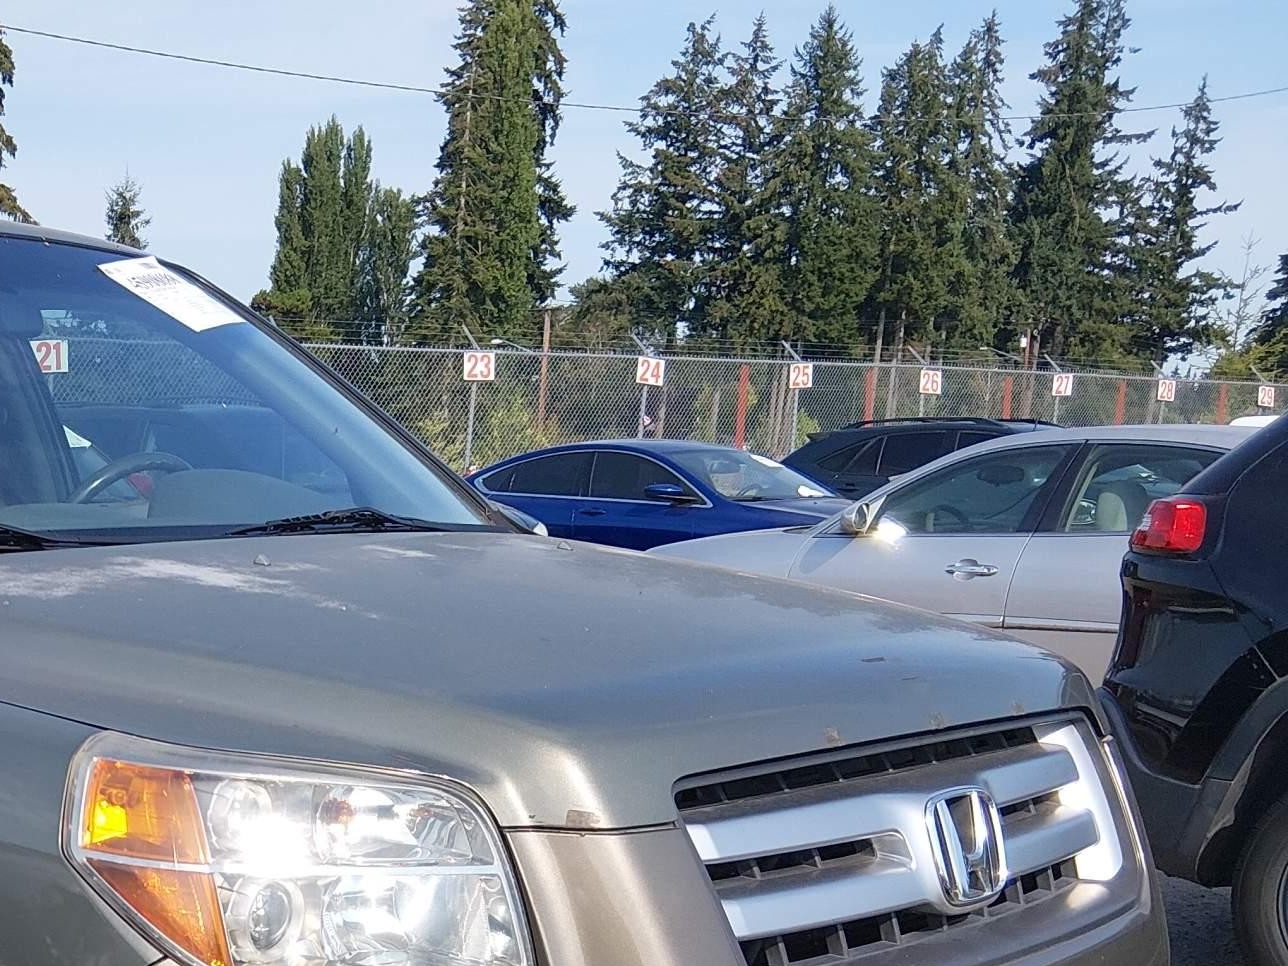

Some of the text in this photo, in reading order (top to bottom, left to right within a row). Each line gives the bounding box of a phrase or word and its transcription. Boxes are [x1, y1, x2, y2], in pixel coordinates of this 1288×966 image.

[36, 342, 62, 371] 21
[467, 354, 491, 379] 23
[639, 360, 662, 384] 24
[792, 366, 810, 388] 25
[921, 371, 939, 393] 26
[1055, 375, 1071, 395] 27
[1160, 380, 1174, 400] 28
[1260, 387, 1274, 405] 29
